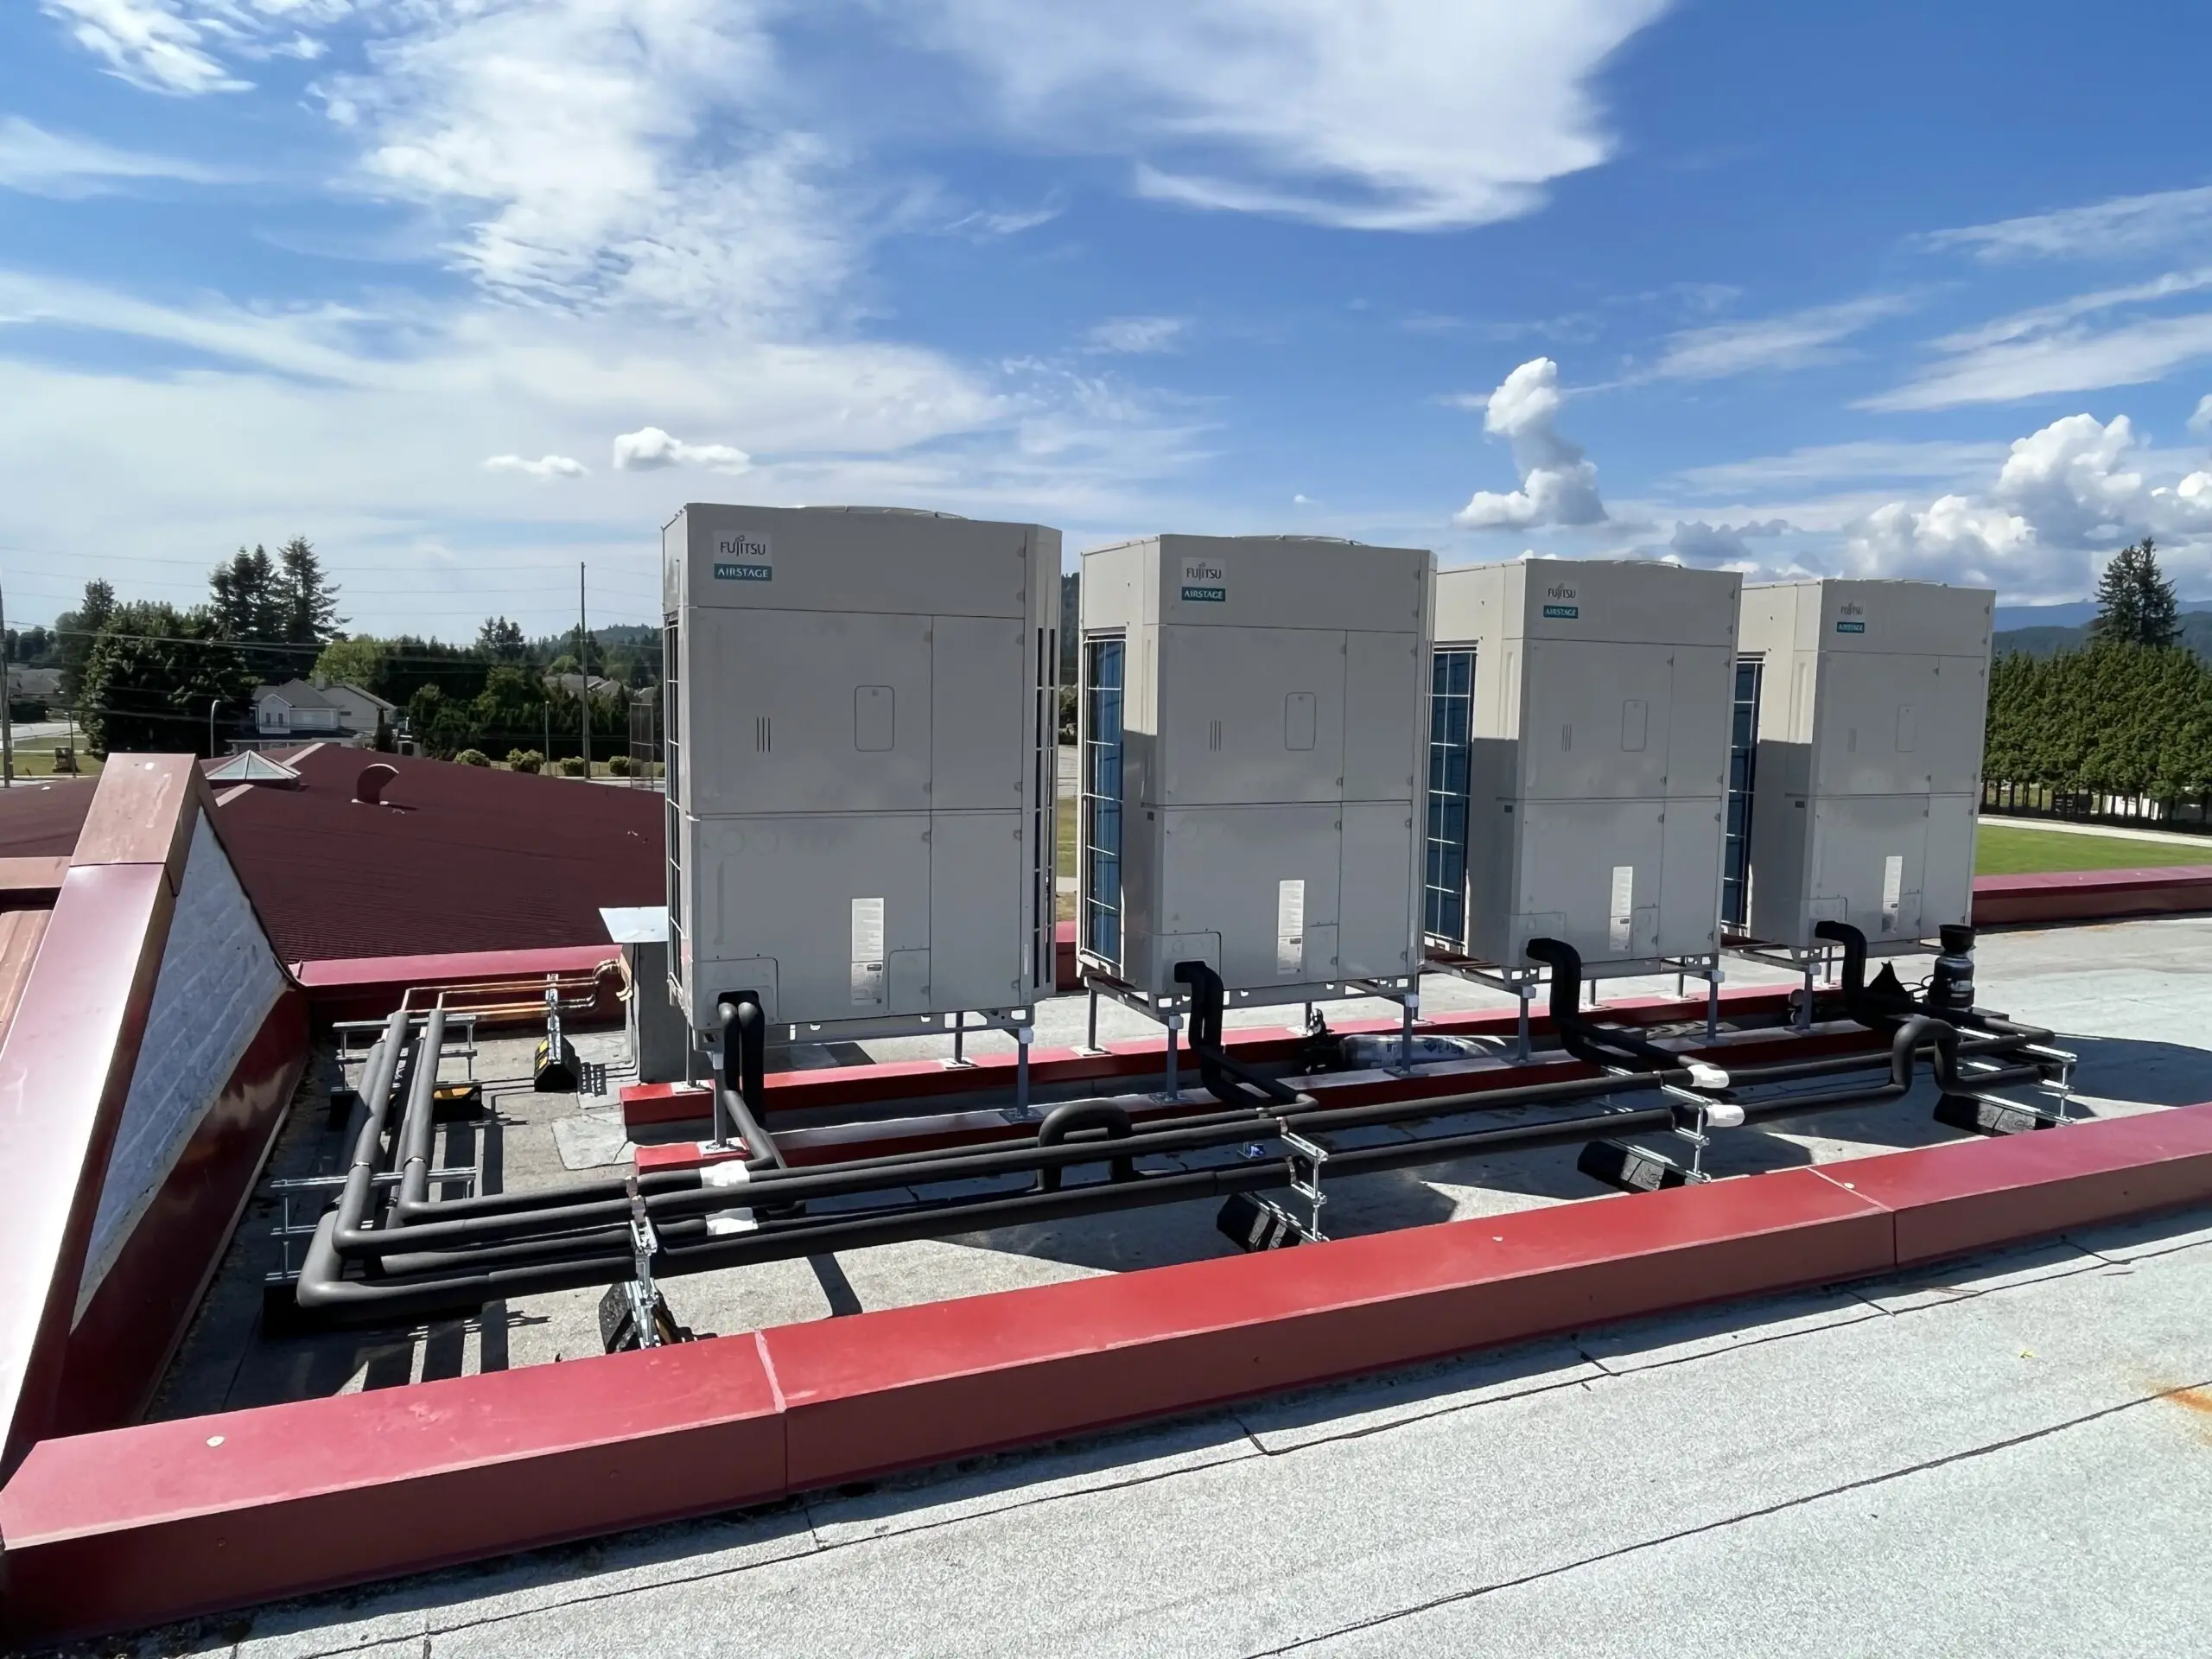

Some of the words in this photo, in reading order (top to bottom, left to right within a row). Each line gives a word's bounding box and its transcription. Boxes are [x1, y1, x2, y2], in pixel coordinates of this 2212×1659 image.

[720, 535, 766, 556] FUJITSU
[717, 567, 769, 579] AIRSTAGE
[1186, 563, 1222, 581] FUJITSU
[1184, 589, 1224, 601] AIRSTAGE
[1548, 582, 1577, 601] FUJITSU
[1545, 607, 1577, 617] AIRSTAGE
